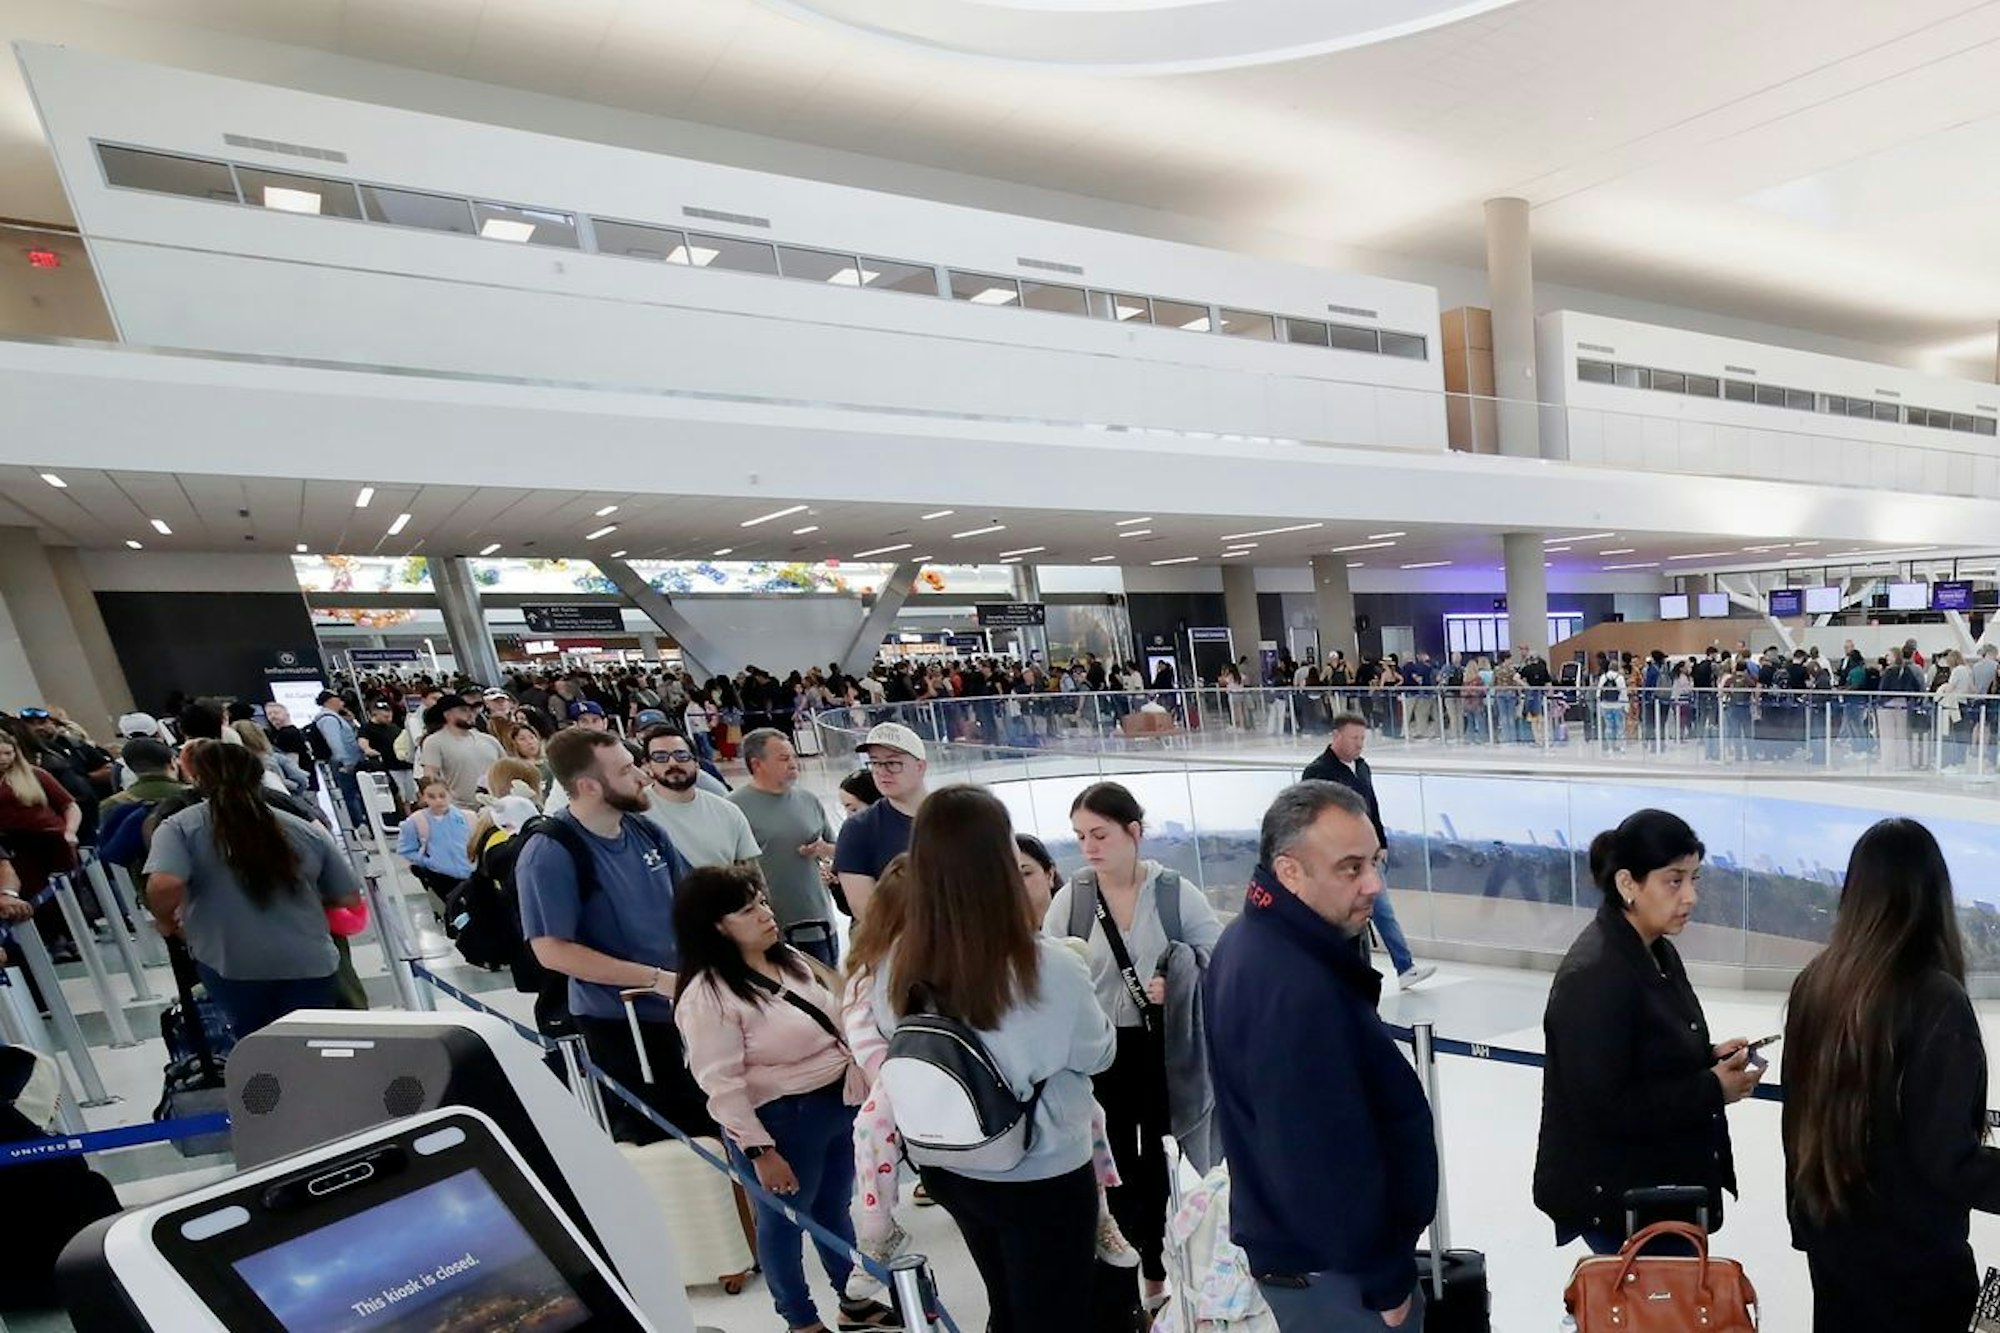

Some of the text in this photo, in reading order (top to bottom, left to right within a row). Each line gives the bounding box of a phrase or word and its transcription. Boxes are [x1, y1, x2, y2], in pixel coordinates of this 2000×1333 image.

[264, 667, 319, 675] Information
[10, 1143, 66, 1157] UNITED
[351, 1252, 480, 1317] This kiosk is closed.
